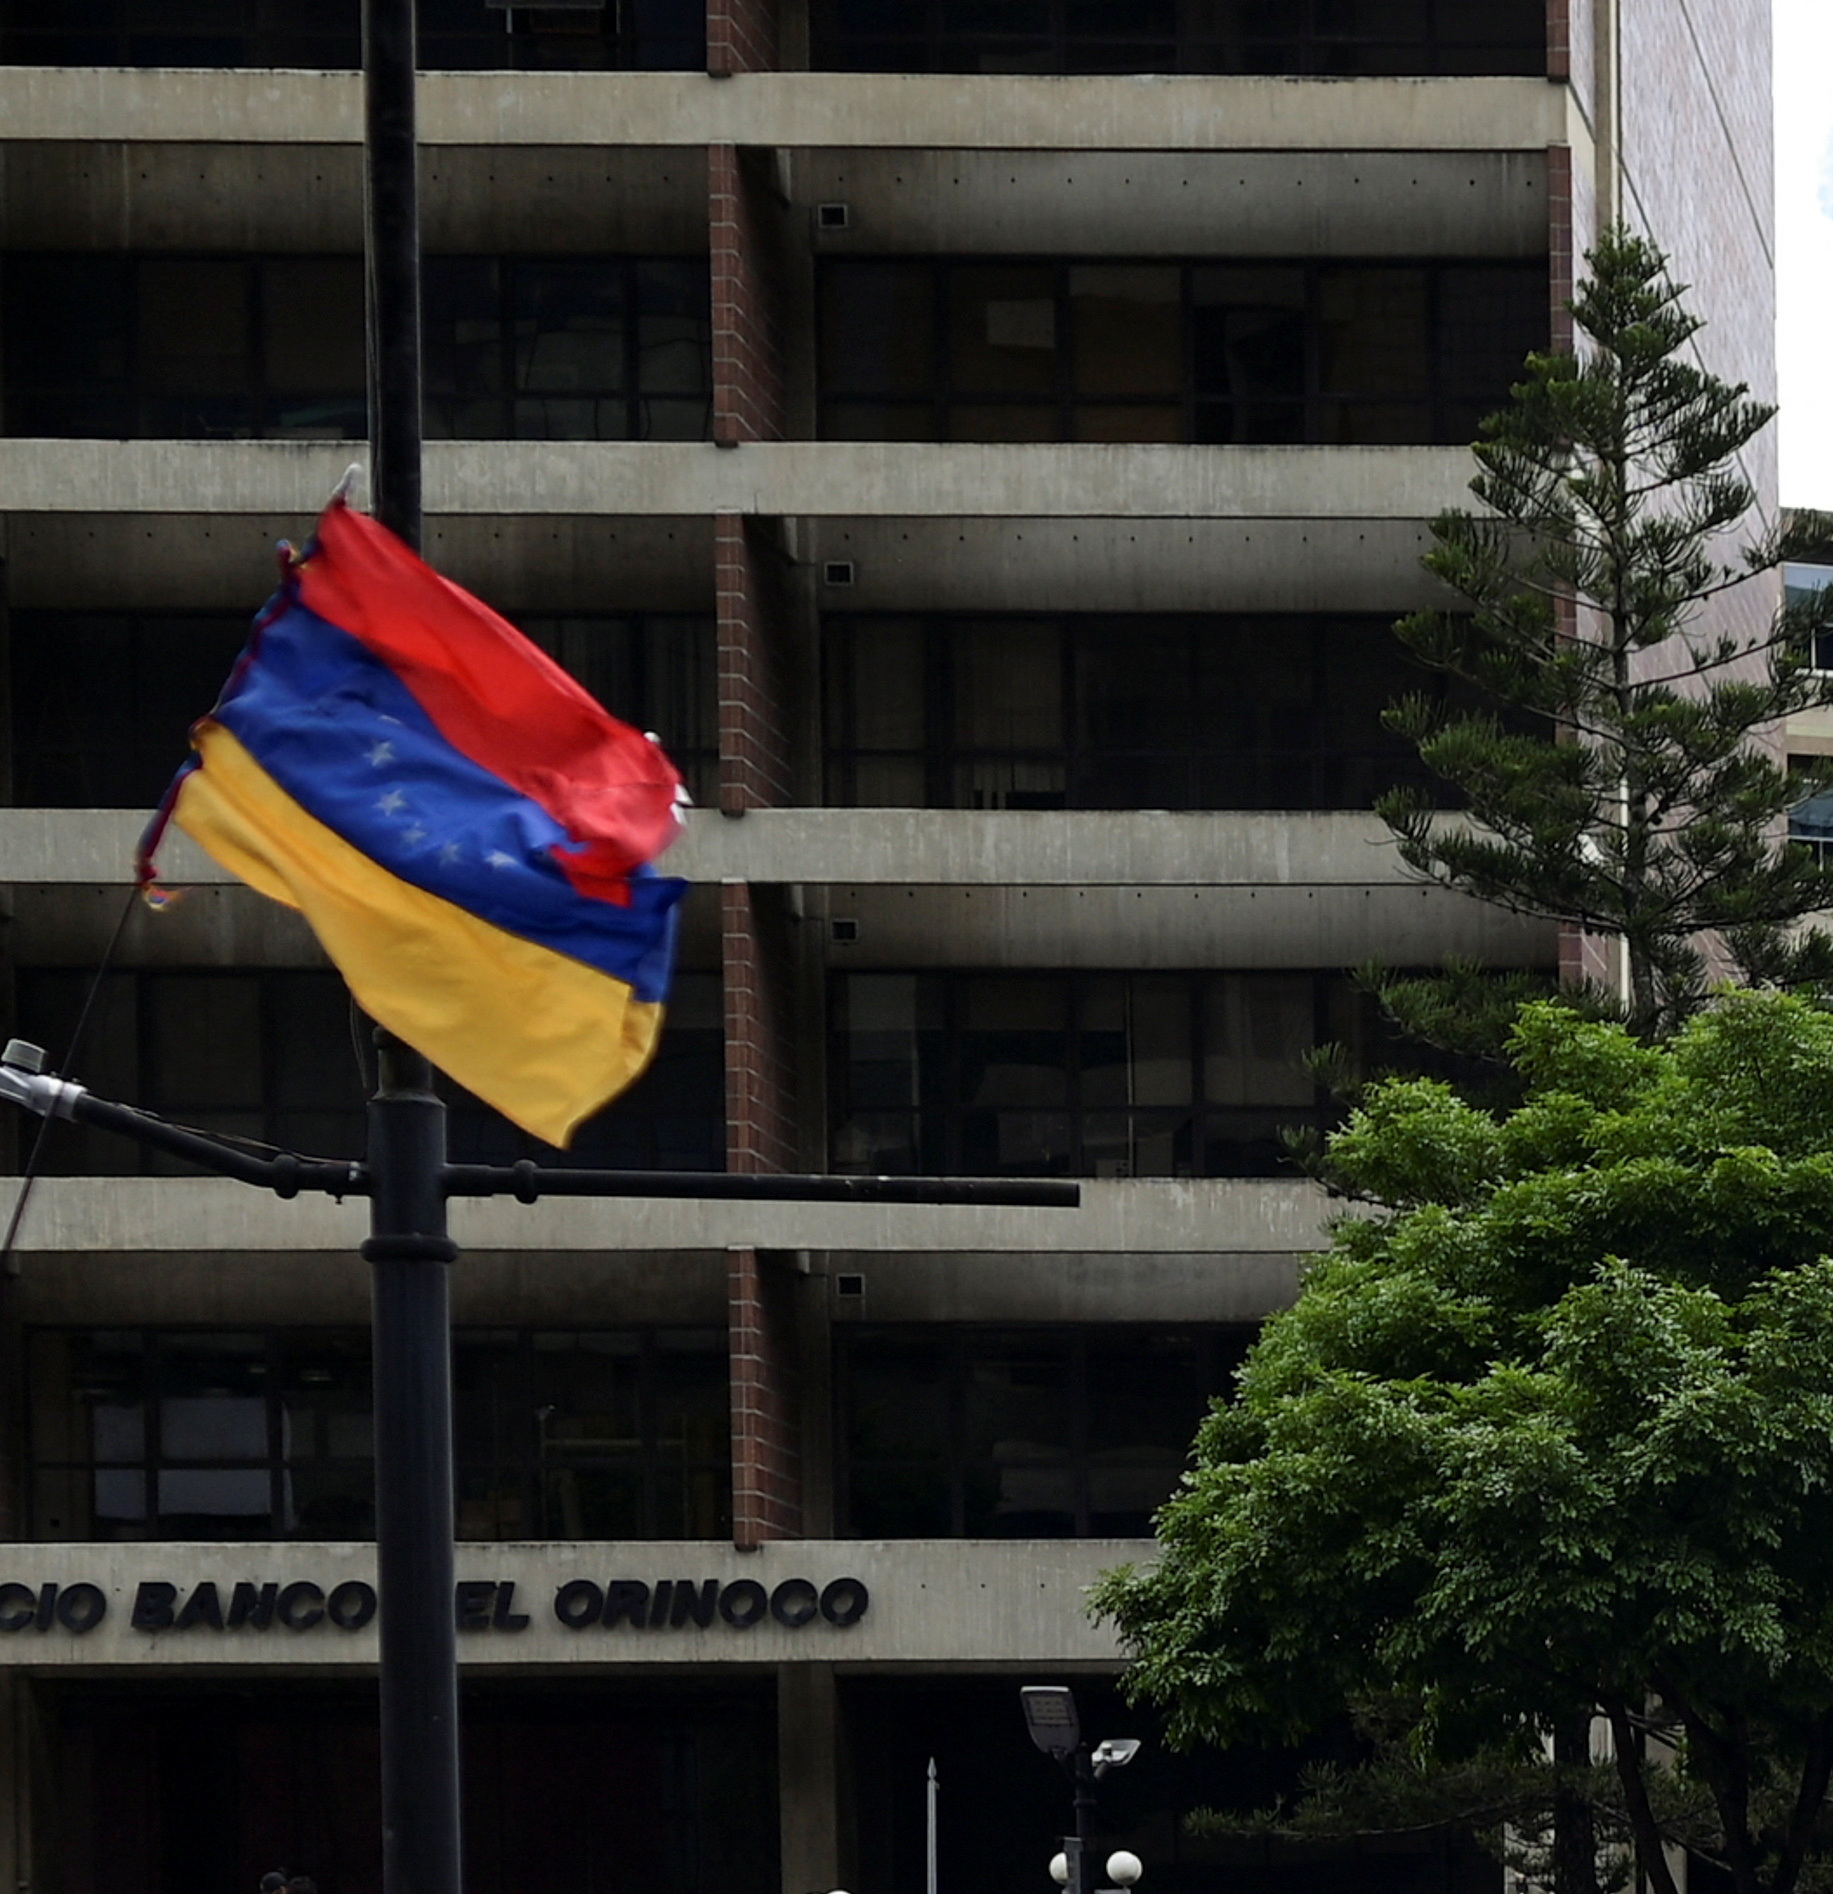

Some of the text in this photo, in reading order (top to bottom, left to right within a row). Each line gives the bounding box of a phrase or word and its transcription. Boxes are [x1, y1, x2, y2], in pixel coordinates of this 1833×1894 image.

[131, 1580, 377, 1630] BANCO
[455, 1581, 530, 1629] EL
[554, 1577, 870, 1628] ORINOCO
